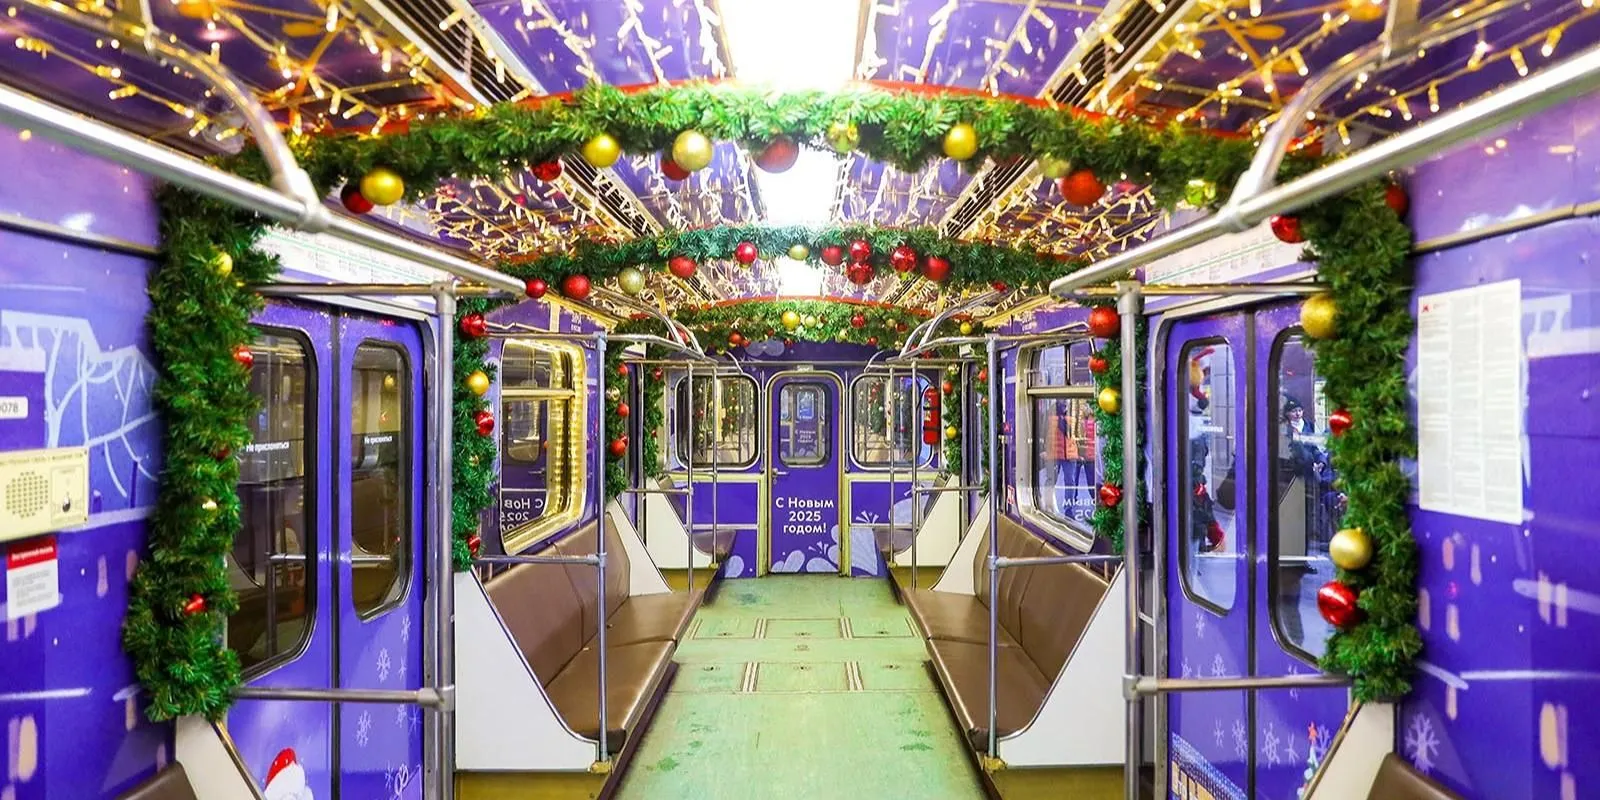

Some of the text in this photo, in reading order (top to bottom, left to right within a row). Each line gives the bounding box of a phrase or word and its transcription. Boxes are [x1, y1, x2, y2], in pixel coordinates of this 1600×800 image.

[0, 402, 19, 413] 078
[775, 497, 834, 508] С Новым
[789, 510, 821, 522] 2025
[783, 522, 827, 535] годом!
